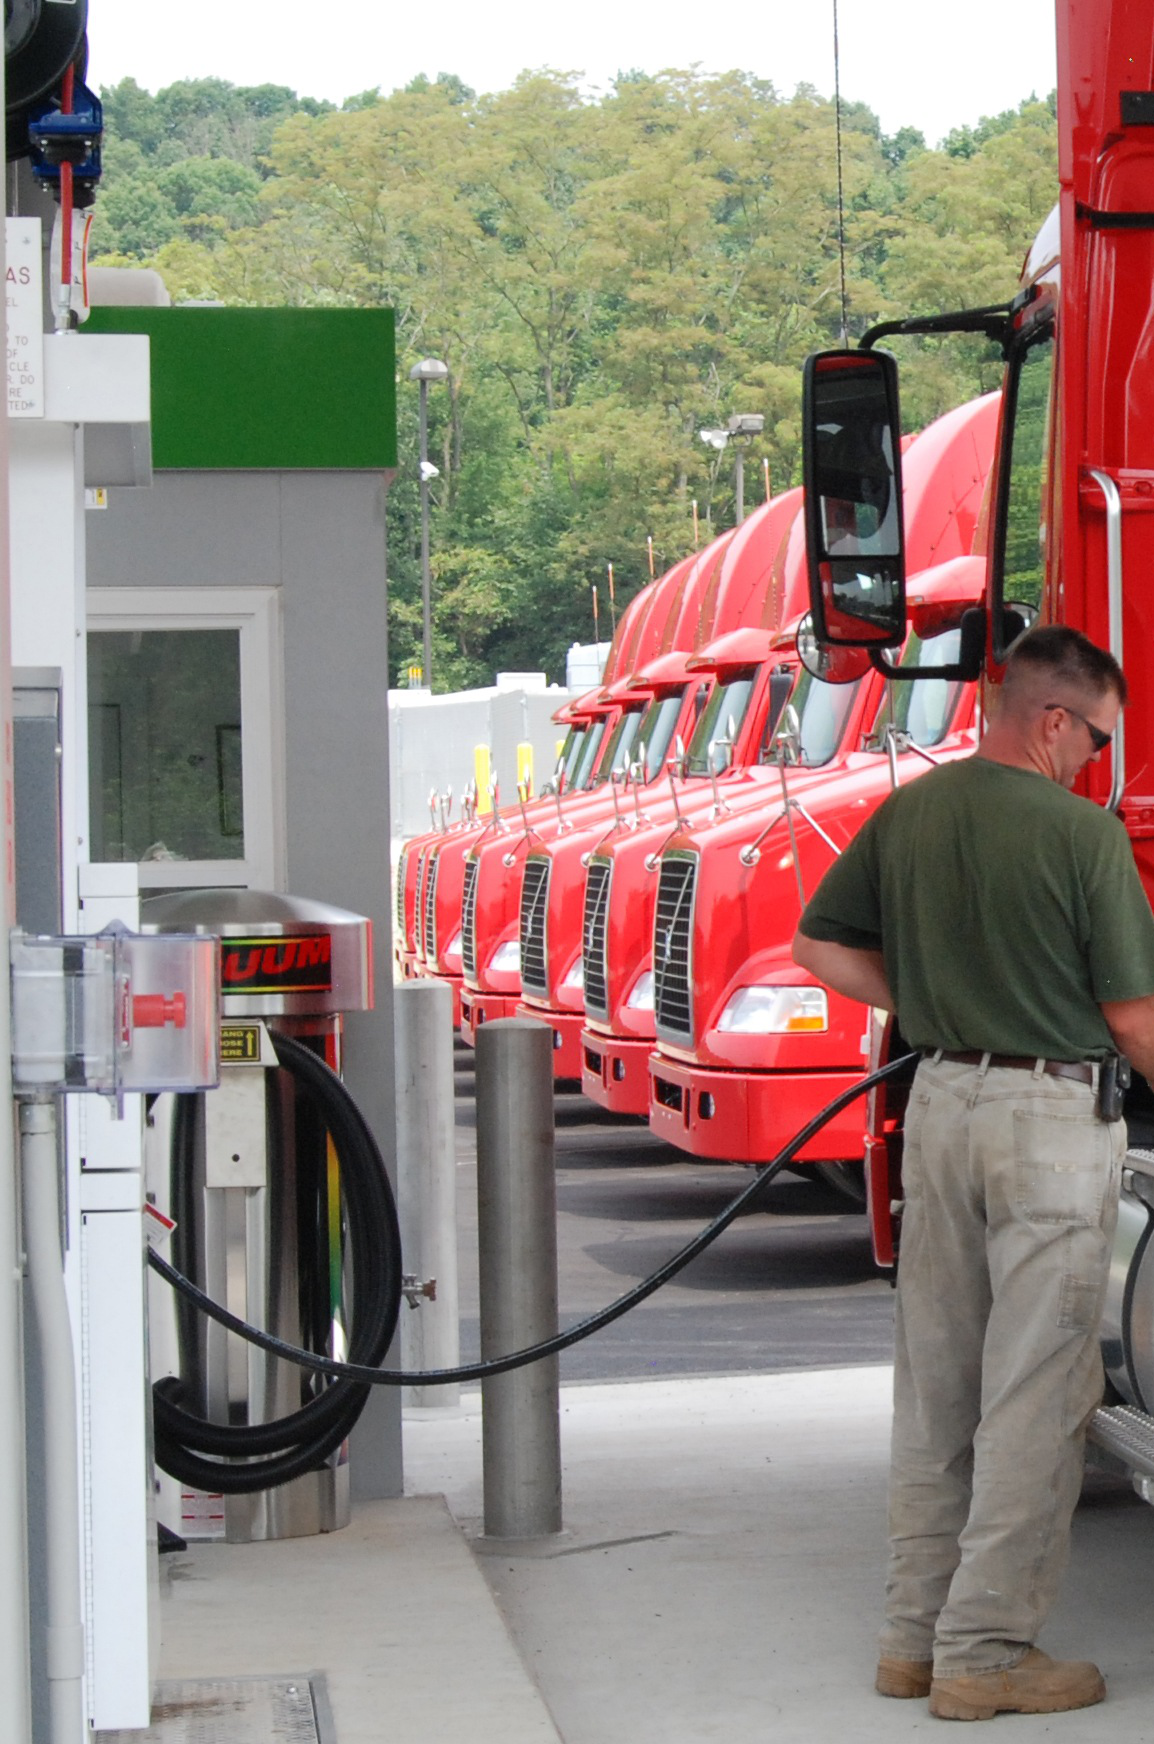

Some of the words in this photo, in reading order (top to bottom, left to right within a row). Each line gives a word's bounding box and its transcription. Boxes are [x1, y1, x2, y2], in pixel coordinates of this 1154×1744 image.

[15, 336, 29, 346] TO
[20, 374, 35, 385] DO
[220, 1049, 243, 1057] ERE
